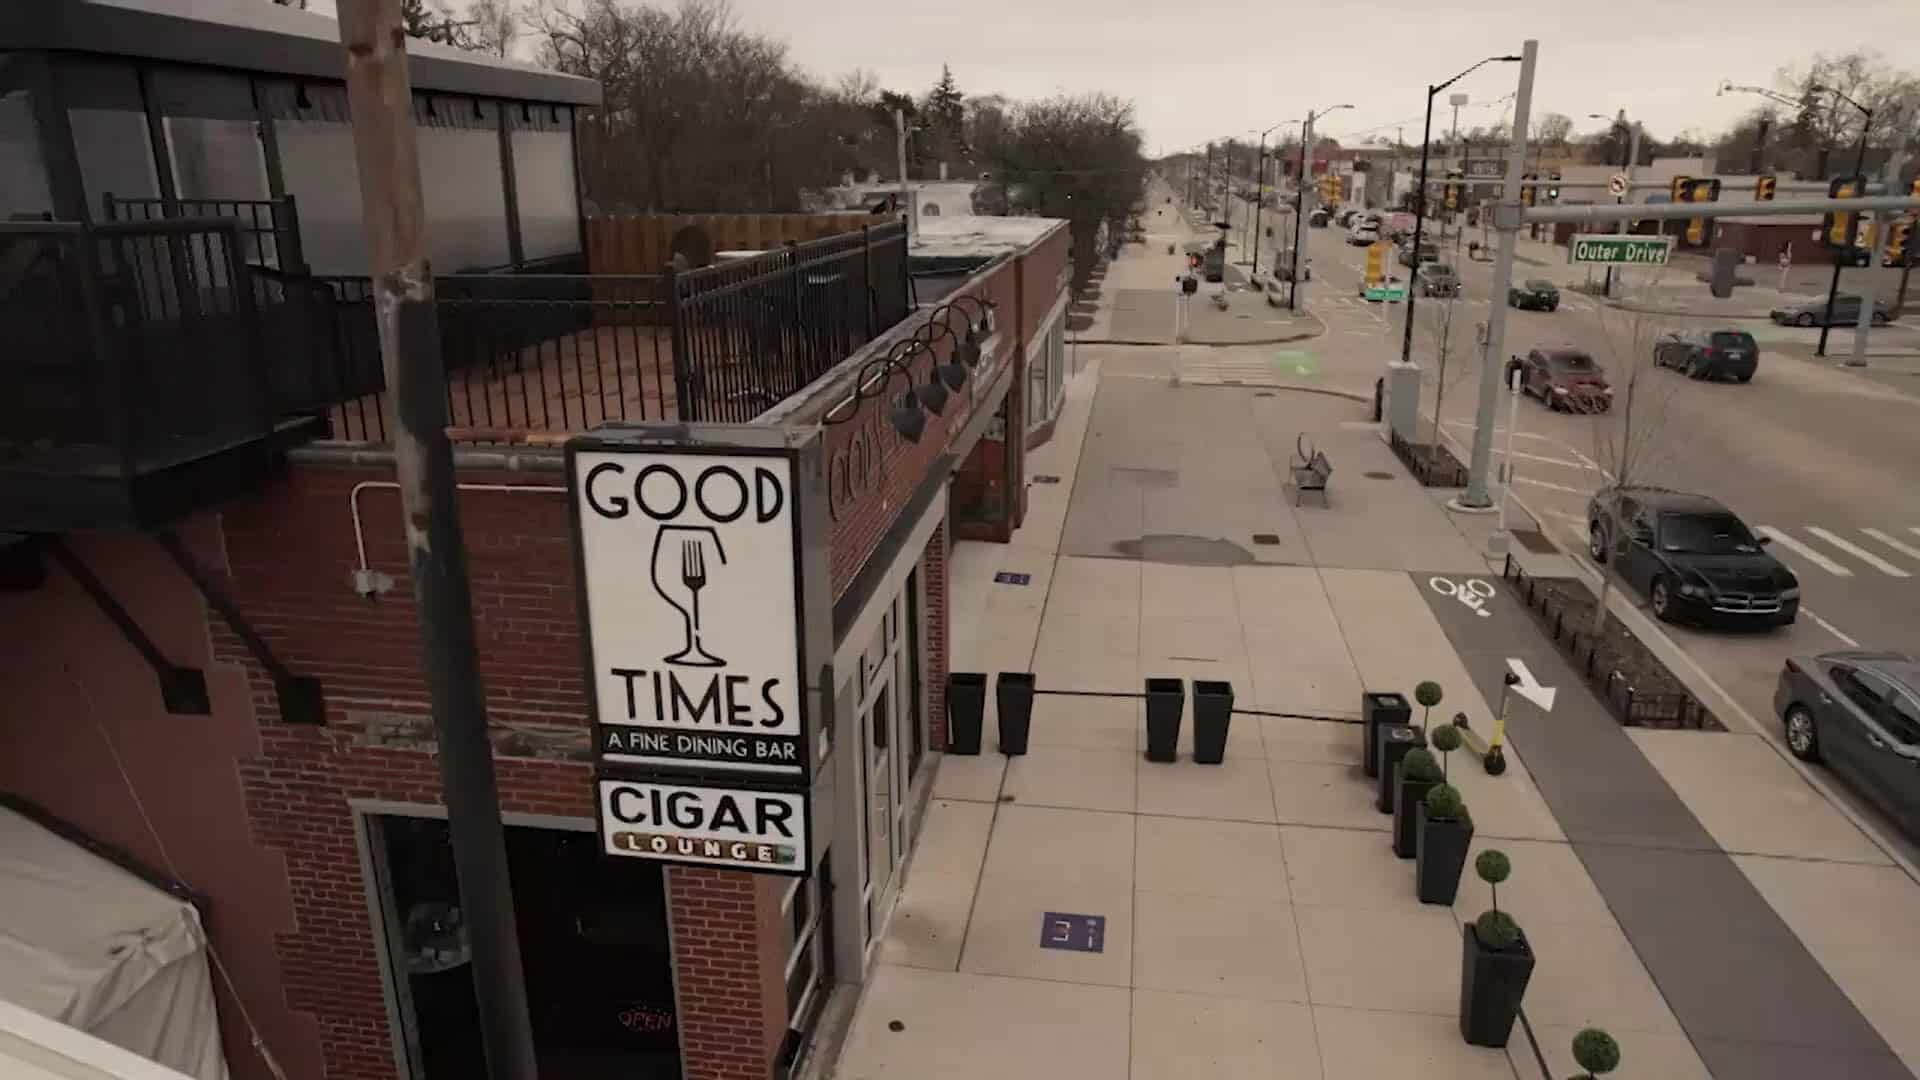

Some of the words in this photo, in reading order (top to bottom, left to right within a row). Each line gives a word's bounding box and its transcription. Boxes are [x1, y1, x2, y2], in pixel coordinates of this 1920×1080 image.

[1578, 243, 1618, 260] Outer
[1625, 244, 1665, 262] Drive
[585, 462, 784, 524] GOOD
[611, 668, 784, 728] TIMES
[608, 733, 622, 748] A
[630, 732, 669, 751] FINE
[678, 736, 747, 757] DINING
[755, 741, 796, 760] BAR
[609, 786, 795, 838] CIGAR
[627, 834, 773, 862] LOUNGE
[617, 1010, 672, 1028] OPEN
